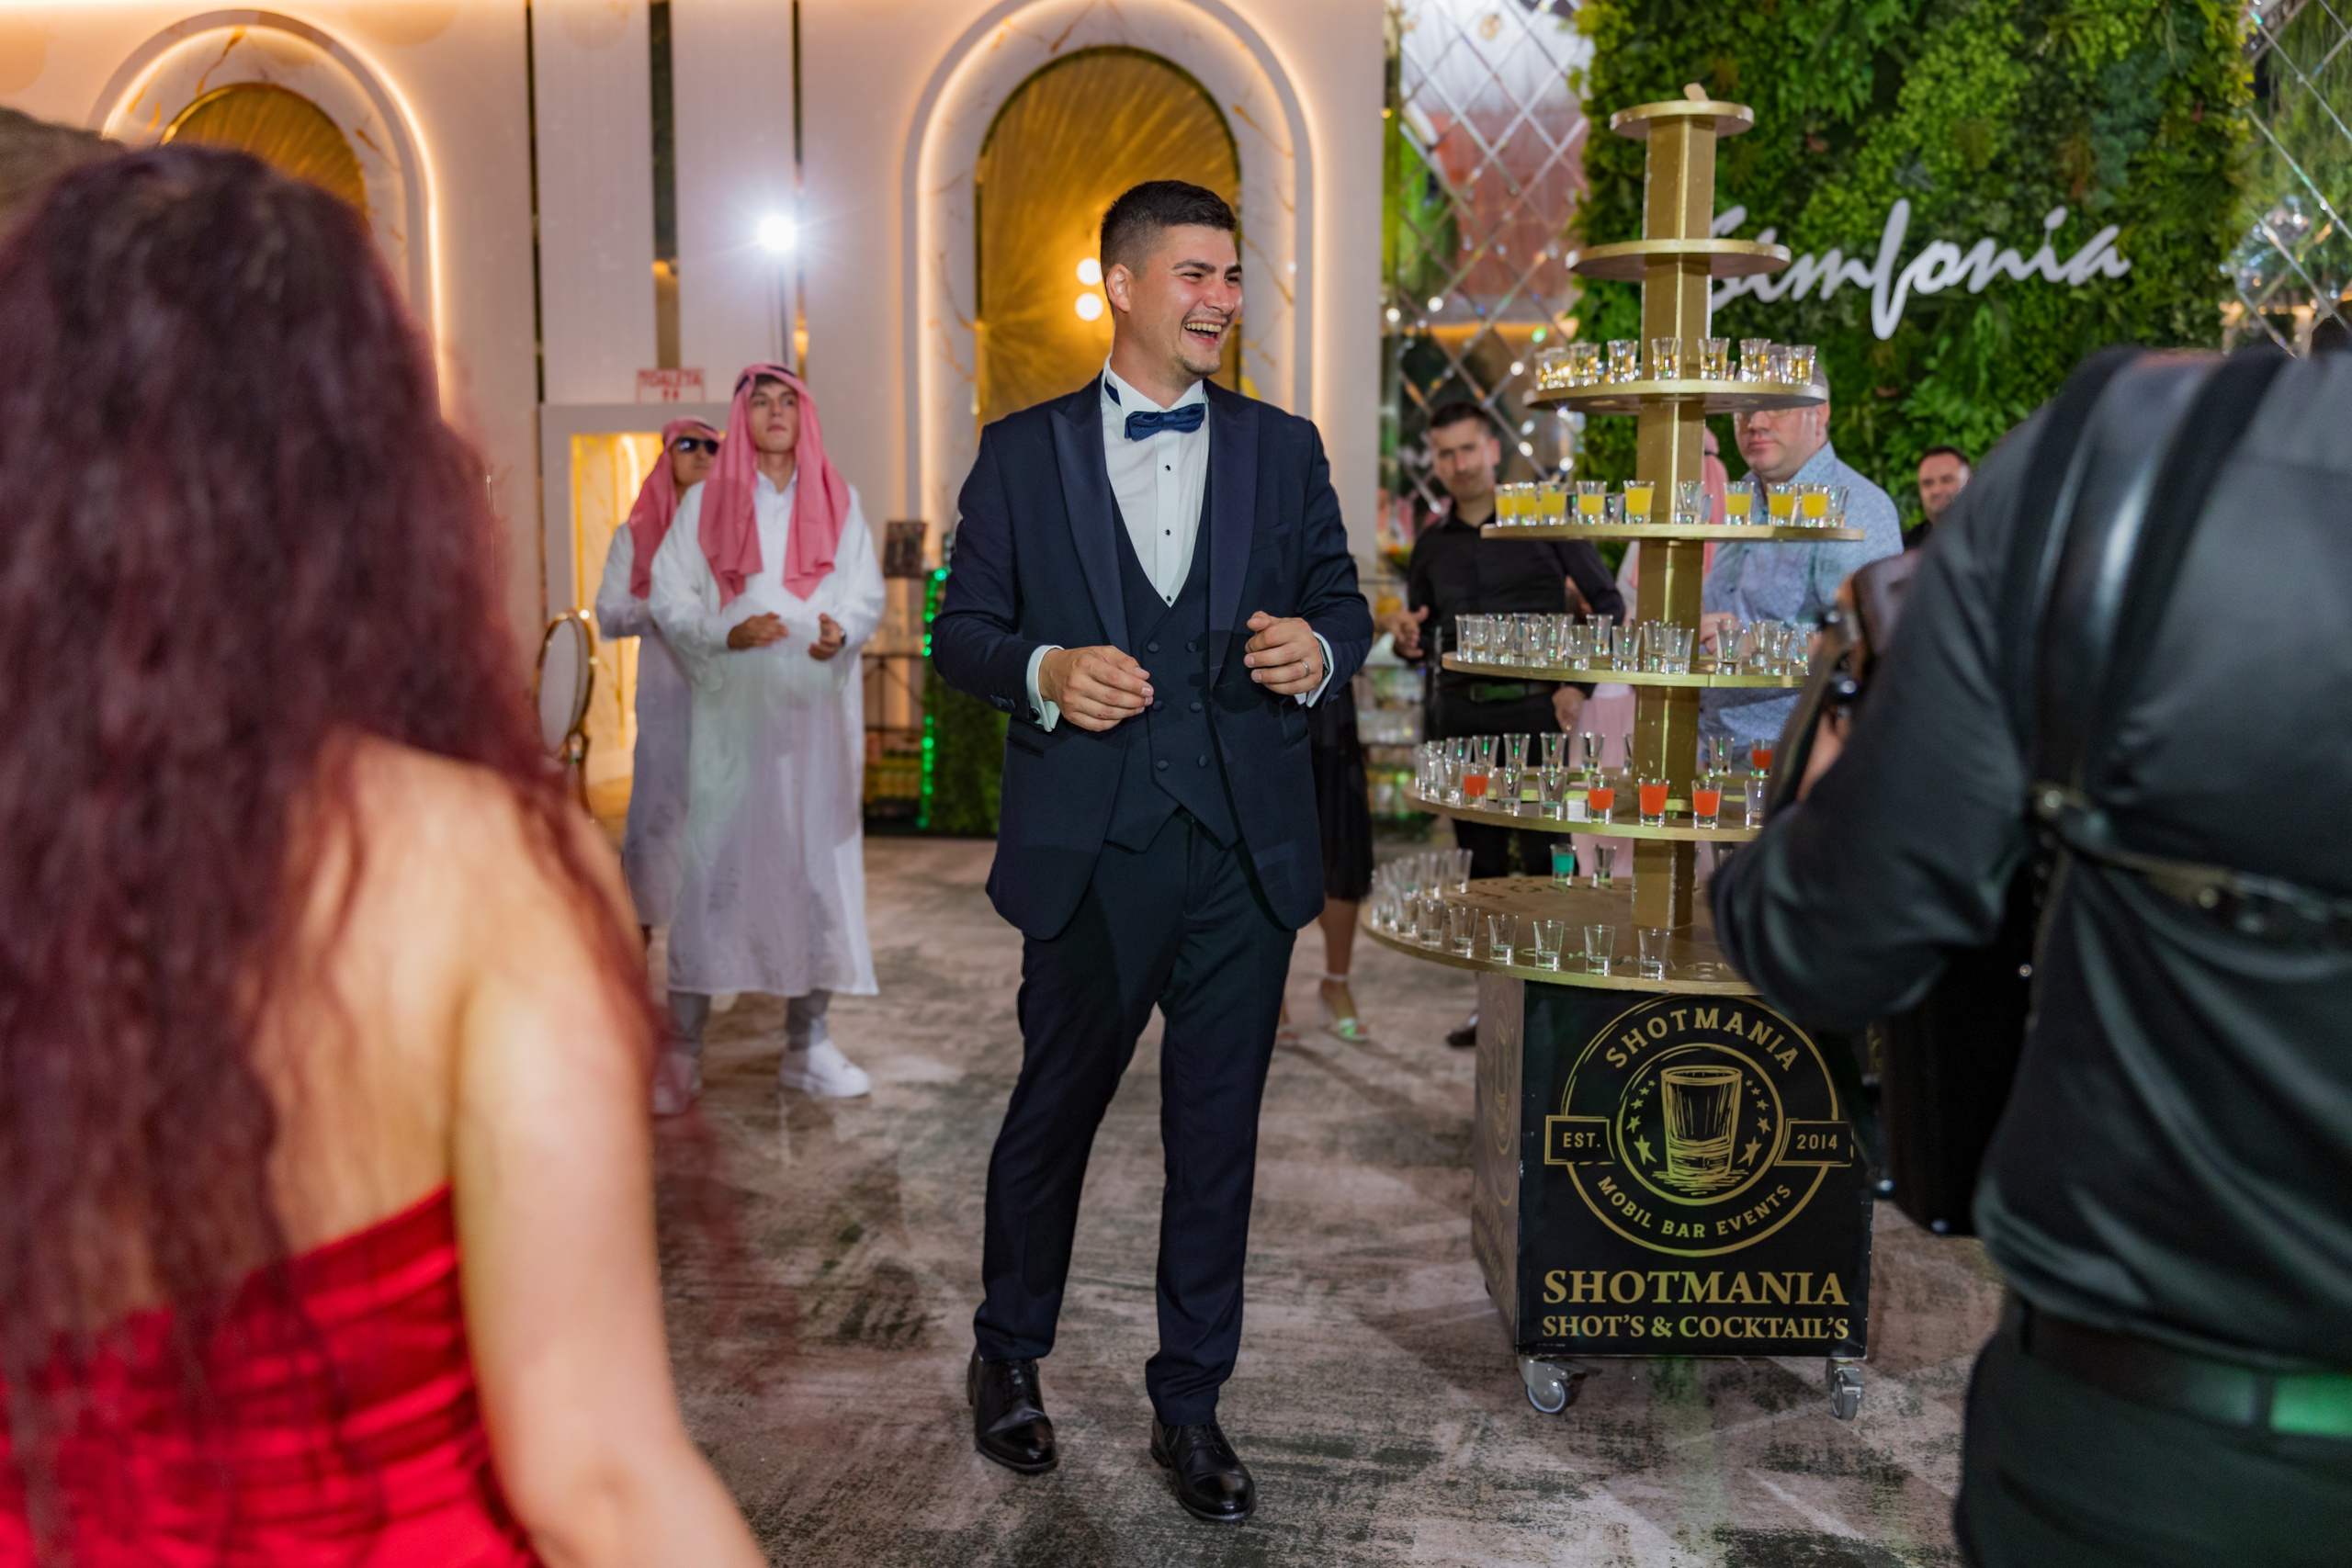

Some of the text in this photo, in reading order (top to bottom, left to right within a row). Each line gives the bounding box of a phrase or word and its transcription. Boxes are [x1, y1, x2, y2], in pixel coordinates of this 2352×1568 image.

[1605, 1008, 1801, 1072] SHOTMANIA
[1563, 1132, 1601, 1148] EST.
[1796, 1134, 1838, 1150] 2014
[1597, 1176, 1792, 1238] MOBIL BAR EVENTS
[1543, 1269, 1850, 1306] SHOTMANIA
[1542, 1314, 1850, 1340] SHOT'S & COCKTAIL'S
